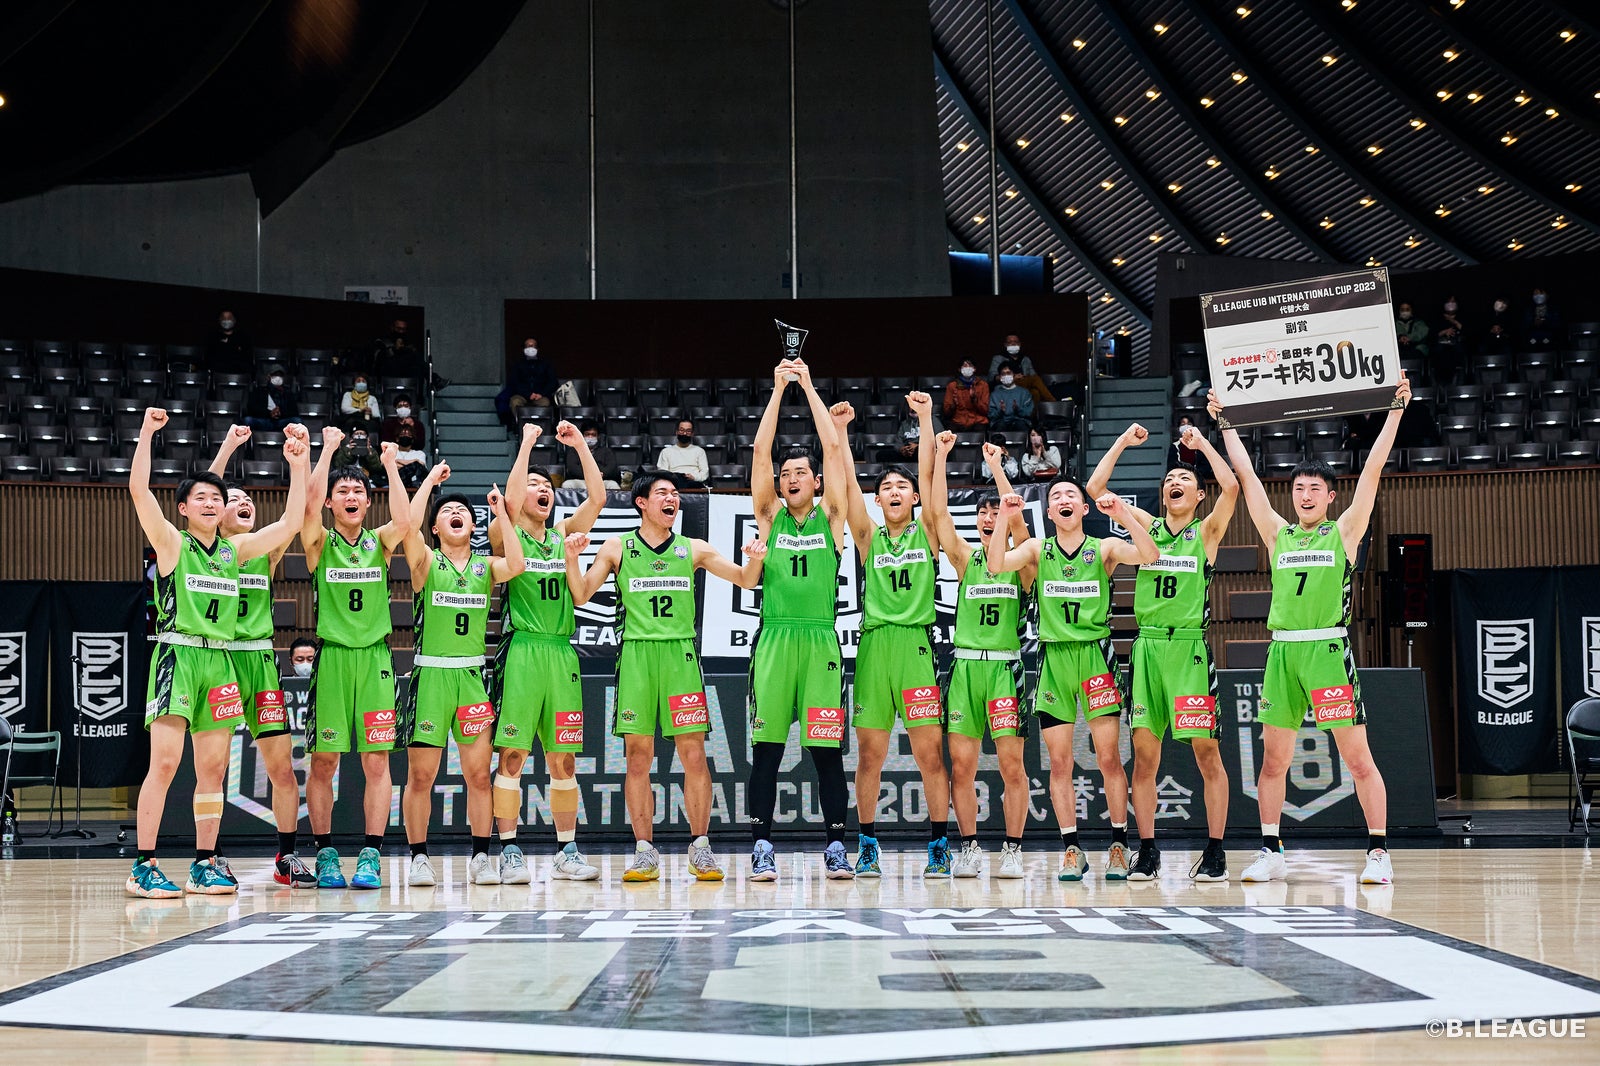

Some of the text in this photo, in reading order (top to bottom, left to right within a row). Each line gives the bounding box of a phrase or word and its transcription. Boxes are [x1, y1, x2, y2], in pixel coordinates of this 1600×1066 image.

[1213, 281, 1376, 313] B.LEAGUE U18 INTERNATIONAL CUP 2023
[1279, 302, 1310, 315] 代替大会
[1285, 320, 1308, 335] 副賞
[1223, 346, 1313, 367] しあわせ絆 島田牛
[789, 554, 808, 577] 11
[536, 577, 560, 601] 10
[888, 568, 912, 592] 14
[1153, 575, 1177, 599] 18
[1294, 571, 1308, 596] 7
[205, 598, 219, 624] 4
[237, 593, 248, 617] 5
[348, 588, 363, 612] 8
[648, 595, 673, 618] 12
[454, 612, 470, 636] 9
[979, 603, 1000, 626] 15
[1060, 601, 1081, 624] 17
[675, 709, 707, 725] Coca-Cola
[909, 703, 940, 718] Coca-Cola
[992, 713, 1018, 729] Coca-Cola
[1177, 713, 1212, 729] Coca-Cola
[1318, 703, 1353, 720] Coca-Cola
[1478, 710, 1533, 725] B.LEAGUE
[73, 723, 128, 738] BLEAGUE
[810, 725, 843, 739] Coca-Cola
[268, 906, 1338, 922] TO THE WORLD
[204, 916, 1399, 941] B.LEAGUE
